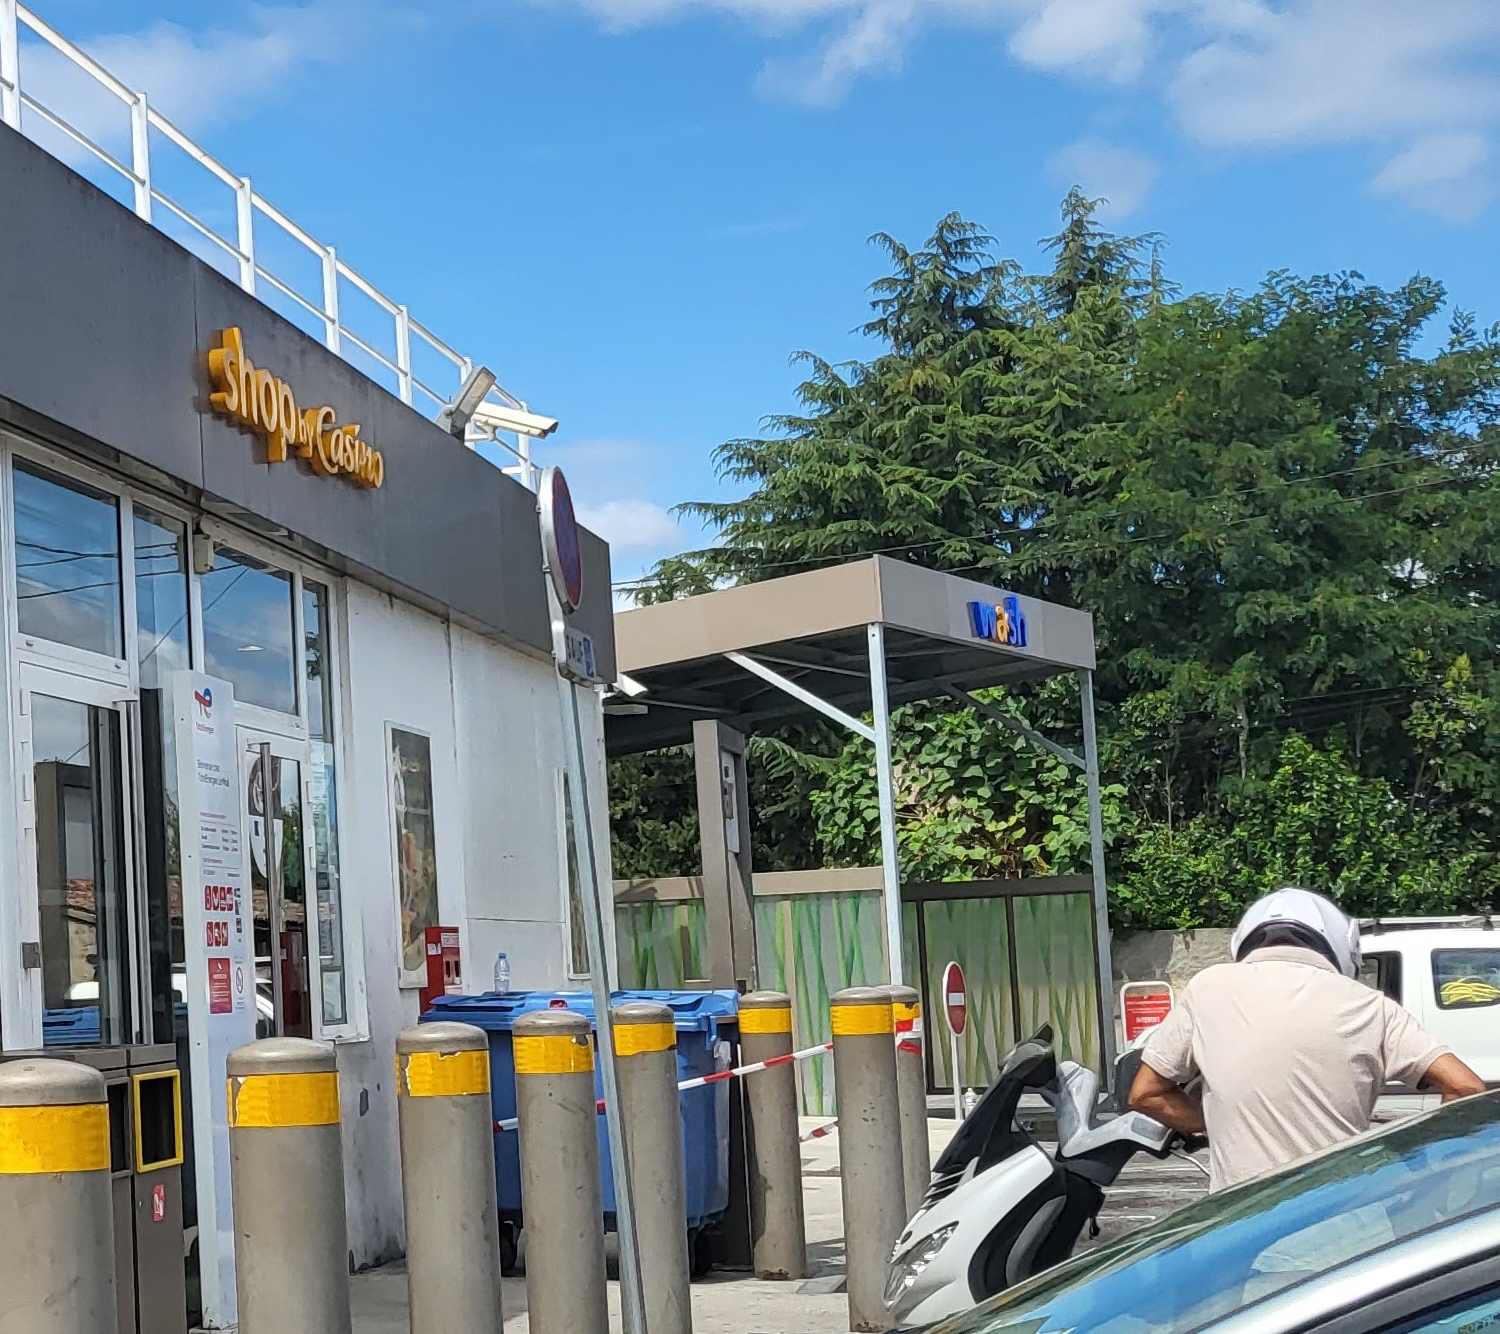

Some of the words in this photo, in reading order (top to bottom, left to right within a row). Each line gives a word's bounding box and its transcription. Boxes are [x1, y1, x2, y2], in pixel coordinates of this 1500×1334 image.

[209, 326, 296, 462] shop
[307, 406, 384, 489] Casino
[966, 595, 1028, 648] wash
